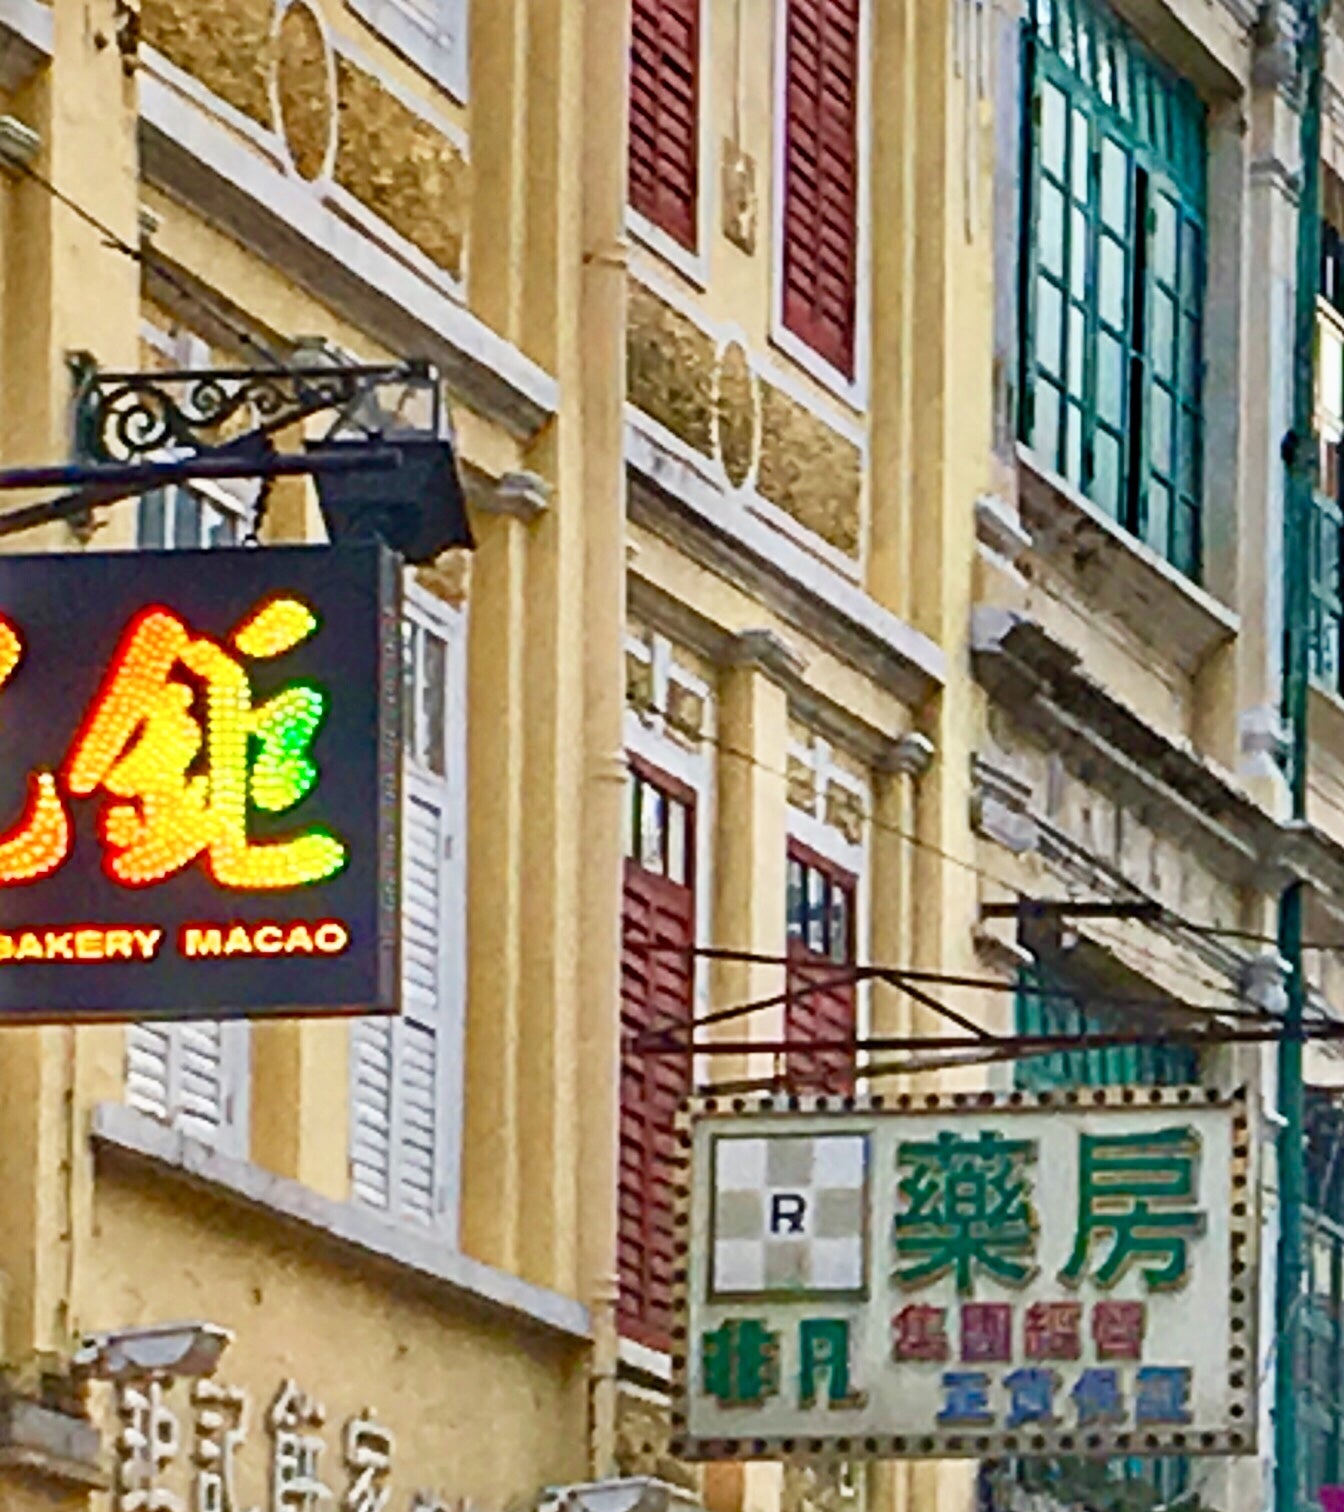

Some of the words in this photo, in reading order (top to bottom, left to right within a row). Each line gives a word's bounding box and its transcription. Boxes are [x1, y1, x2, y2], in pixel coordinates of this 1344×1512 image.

[184, 922, 348, 957] MACAO
[892, 1124, 1208, 1298] 藥房
[701, 1317, 866, 1411] 非凡
